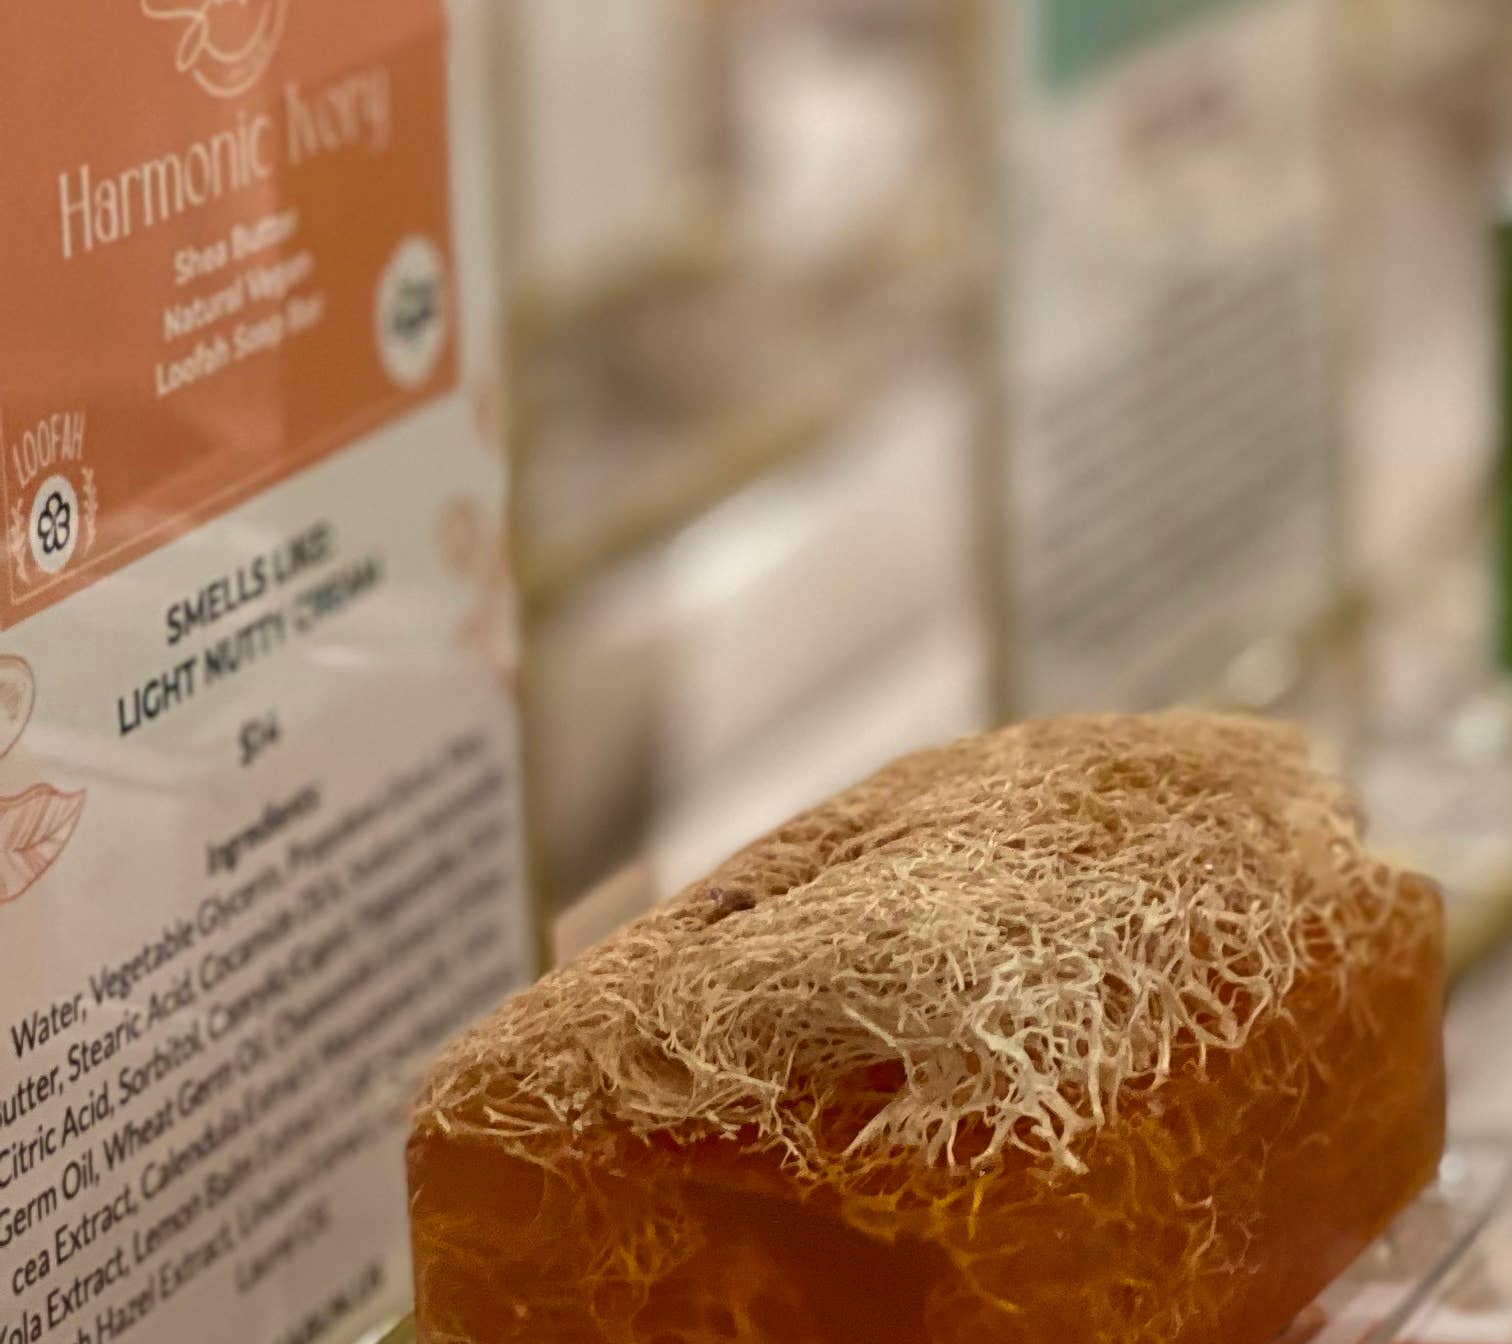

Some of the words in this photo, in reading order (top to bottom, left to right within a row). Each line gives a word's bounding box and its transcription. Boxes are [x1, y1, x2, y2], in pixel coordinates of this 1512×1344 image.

[58, 110, 273, 260] Harmonic
[163, 278, 246, 342] Natural
[12, 411, 86, 488] LOOFAH
[165, 554, 267, 646] SMELLS
[116, 654, 198, 738] LIGHT
[203, 610, 286, 684] NUTTY
[10, 993, 88, 1059] Water,
[89, 916, 195, 1006] Vegetable
[0, 1065, 65, 1128] utter,
[66, 1008, 143, 1083] Stearic
[0, 1125, 58, 1190] Citric
[60, 1079, 116, 1148] Acid,
[0, 1185, 58, 1249] Germ
[61, 1147, 101, 1202] Oil,
[102, 1099, 177, 1171] Wheat
[11, 1248, 51, 1297] cea
[54, 1183, 139, 1267] Extract,
[46, 1246, 130, 1332] Extract,
